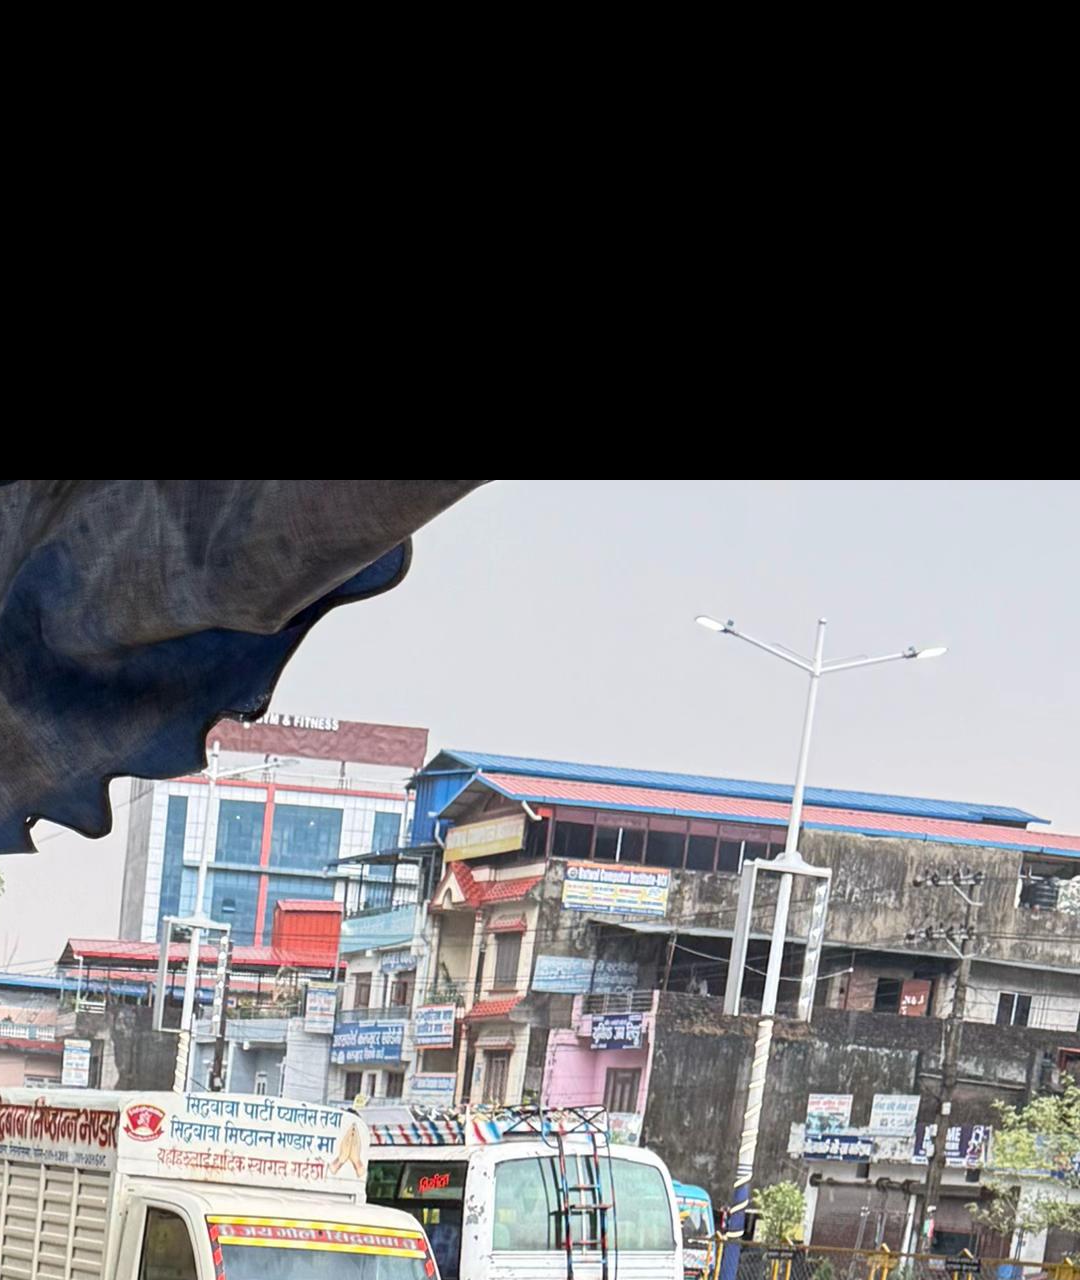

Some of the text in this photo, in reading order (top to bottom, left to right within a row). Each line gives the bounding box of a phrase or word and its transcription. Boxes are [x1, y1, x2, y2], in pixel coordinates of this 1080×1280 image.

[281, 714, 291, 727] &
[294, 715, 339, 731] FITNESS
[319, 1110, 343, 1129] तथा
[277, 1131, 315, 1153] भण्डार
[316, 1135, 337, 1154] मा
[247, 1155, 288, 1180] स्वागत
